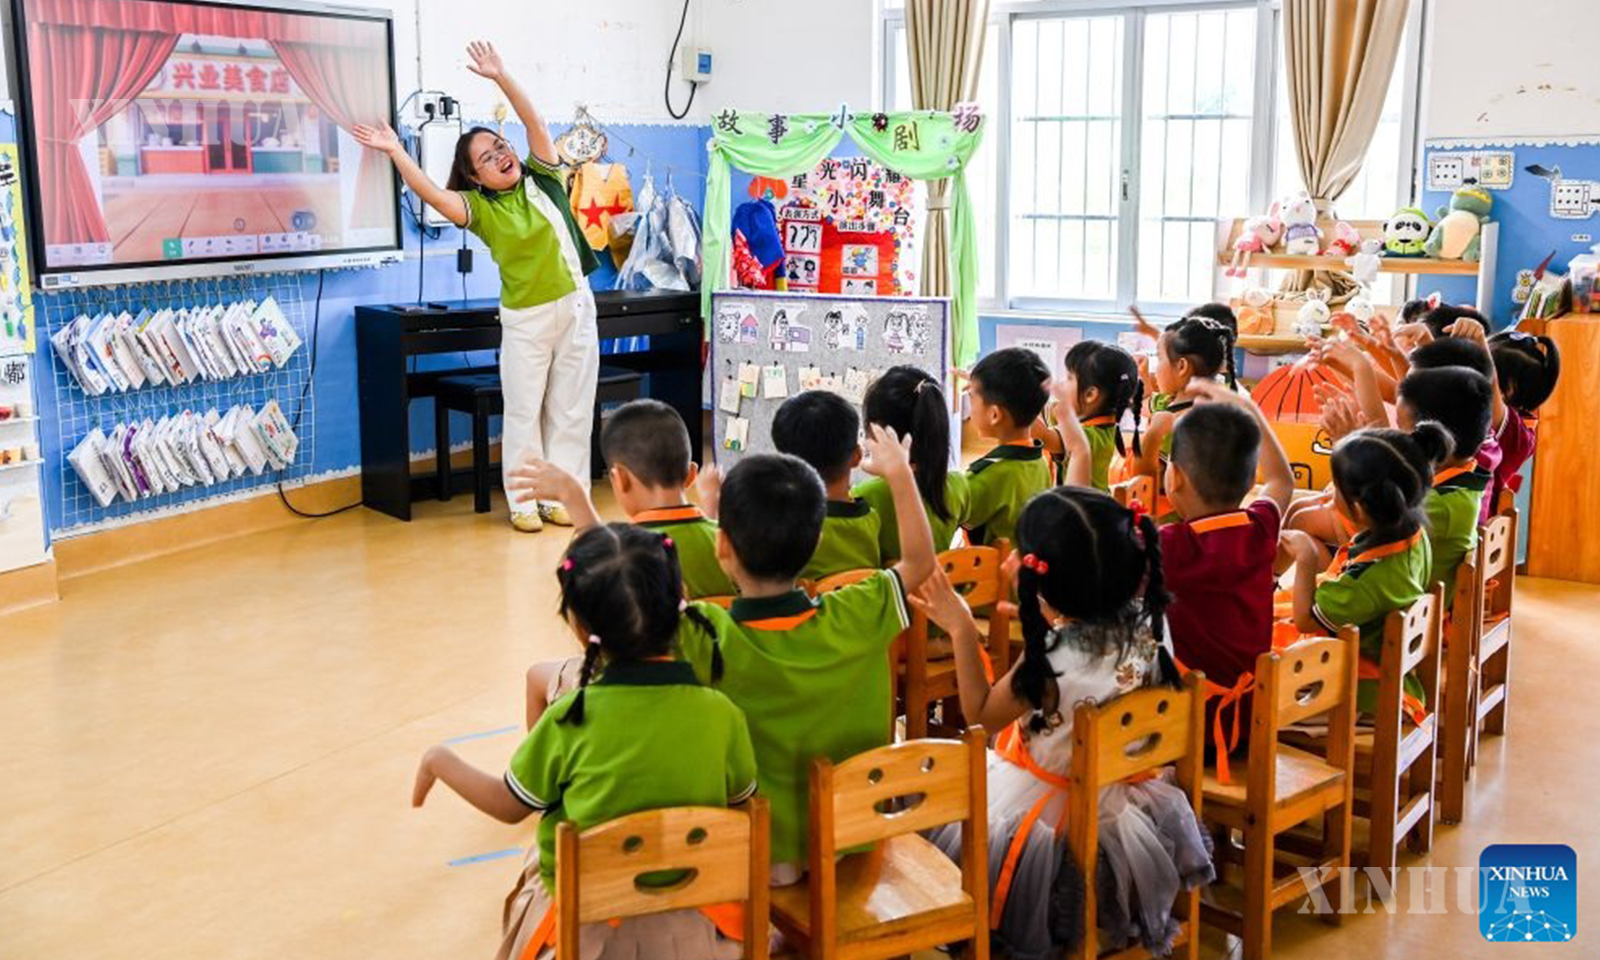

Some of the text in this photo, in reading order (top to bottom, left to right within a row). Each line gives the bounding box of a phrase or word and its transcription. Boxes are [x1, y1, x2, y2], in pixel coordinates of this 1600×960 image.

[172, 61, 291, 93] 兴业美食店
[717, 104, 980, 152] 故事小剧场
[828, 189, 911, 226] 小舞台
